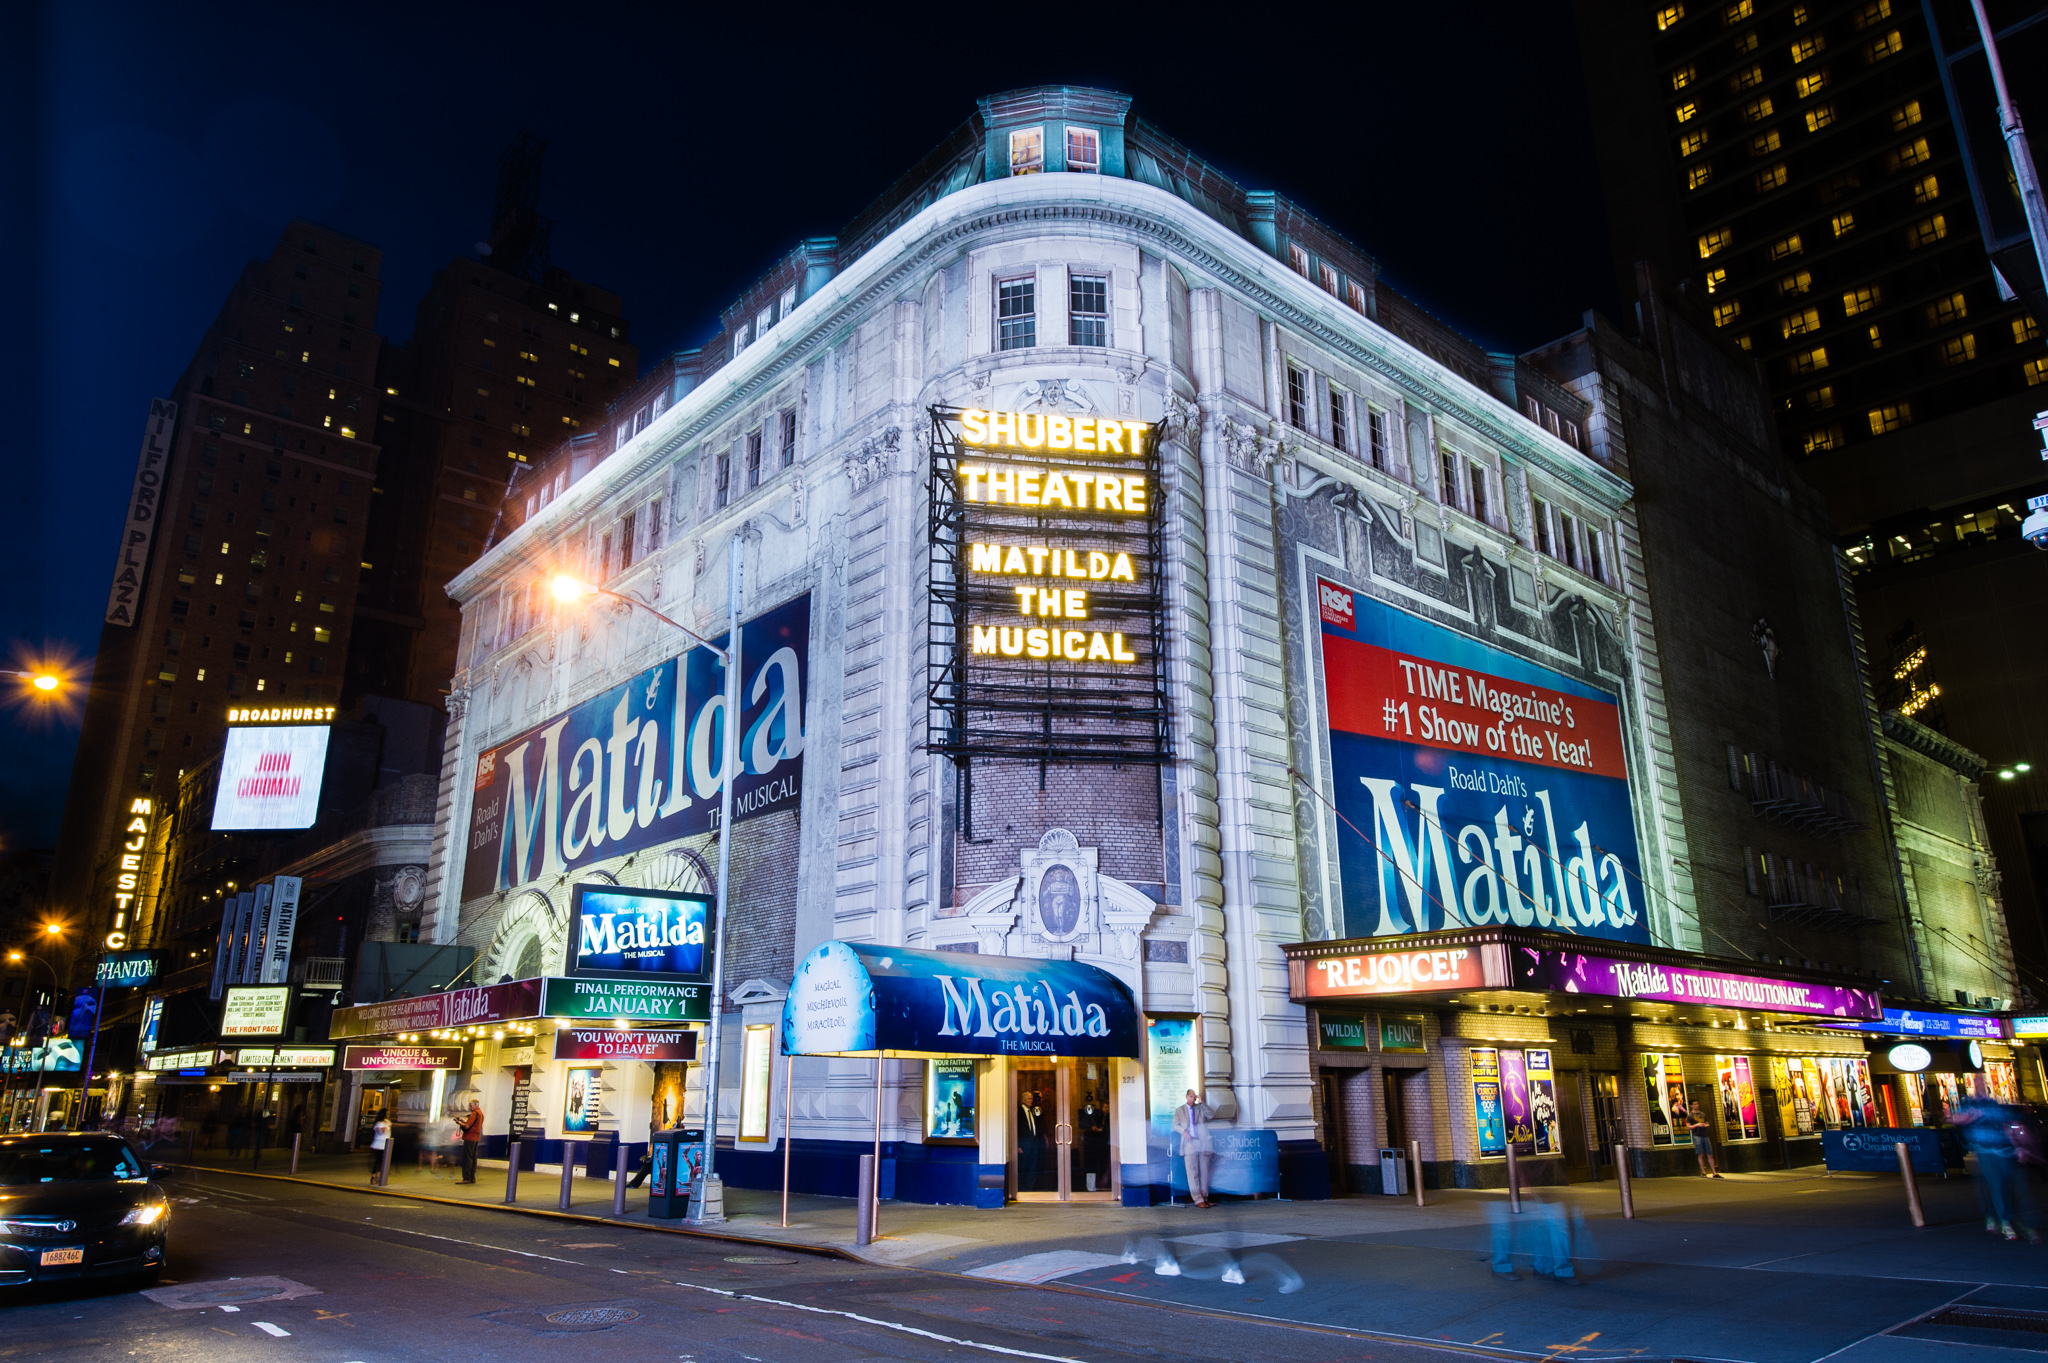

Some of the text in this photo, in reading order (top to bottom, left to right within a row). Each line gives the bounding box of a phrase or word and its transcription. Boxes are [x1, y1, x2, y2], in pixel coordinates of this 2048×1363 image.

[961, 408, 1147, 455] SHUBERT
[959, 466, 1146, 512] THEATRE
[108, 402, 176, 623] MILFORD PLAZA
[971, 543, 1134, 581] MATILDA
[1015, 586, 1087, 618] THE
[1320, 584, 1353, 616] RSC
[972, 625, 1135, 662] MUSICAL
[1398, 659, 1576, 729] TIME Magazine's
[228, 707, 335, 722] BROADHURST
[1383, 696, 1593, 768] #1 Show of the Year!
[255, 752, 292, 772] JOHN
[478, 751, 496, 777] RSC
[494, 627, 806, 889] Matilda
[236, 776, 301, 799] GOODMAN
[1449, 766, 1528, 798] Roald Dahl's
[736, 775, 798, 817] MUSICAL
[476, 796, 499, 826] Roald
[473, 821, 499, 850] Dahl's
[1359, 776, 1638, 937] Matilda
[106, 798, 151, 949] MAJESTIC
[276, 901, 294, 937] NATHAN
[578, 907, 705, 956] Matilda
[273, 939, 288, 962] LANE
[623, 950, 665, 960] THE MUSICAL
[95, 959, 159, 980] PHANTOM
[574, 983, 698, 998] FINAL PERFORMANCE
[1671, 973, 1684, 996] IS
[1684, 974, 1722, 999] TRULY
[380, 1007, 387, 1017] TO
[388, 1005, 397, 1016] THE
[441, 988, 490, 1027] Matilda
[584, 996, 686, 1015] JANUARY 1
[933, 974, 1111, 1038] Matilda
[239, 1025, 261, 1033] FRONT
[262, 1025, 279, 1033] PAGE
[411, 1014, 429, 1028] WORLD
[429, 1014, 438, 1026] OF
[596, 1043, 615, 1053] TO
[604, 1032, 645, 1044] WON'T
[647, 1033, 682, 1044] WANT
[1002, 1040, 1056, 1051] THE MUSICAL
[1159, 1046, 1182, 1054] Matilda
[240, 1055, 262, 1064] LIMITED
[421, 1049, 430, 1057] &
[1227, 1135, 1261, 1148] Shubert
[1861, 1133, 1920, 1143] The Shubert
